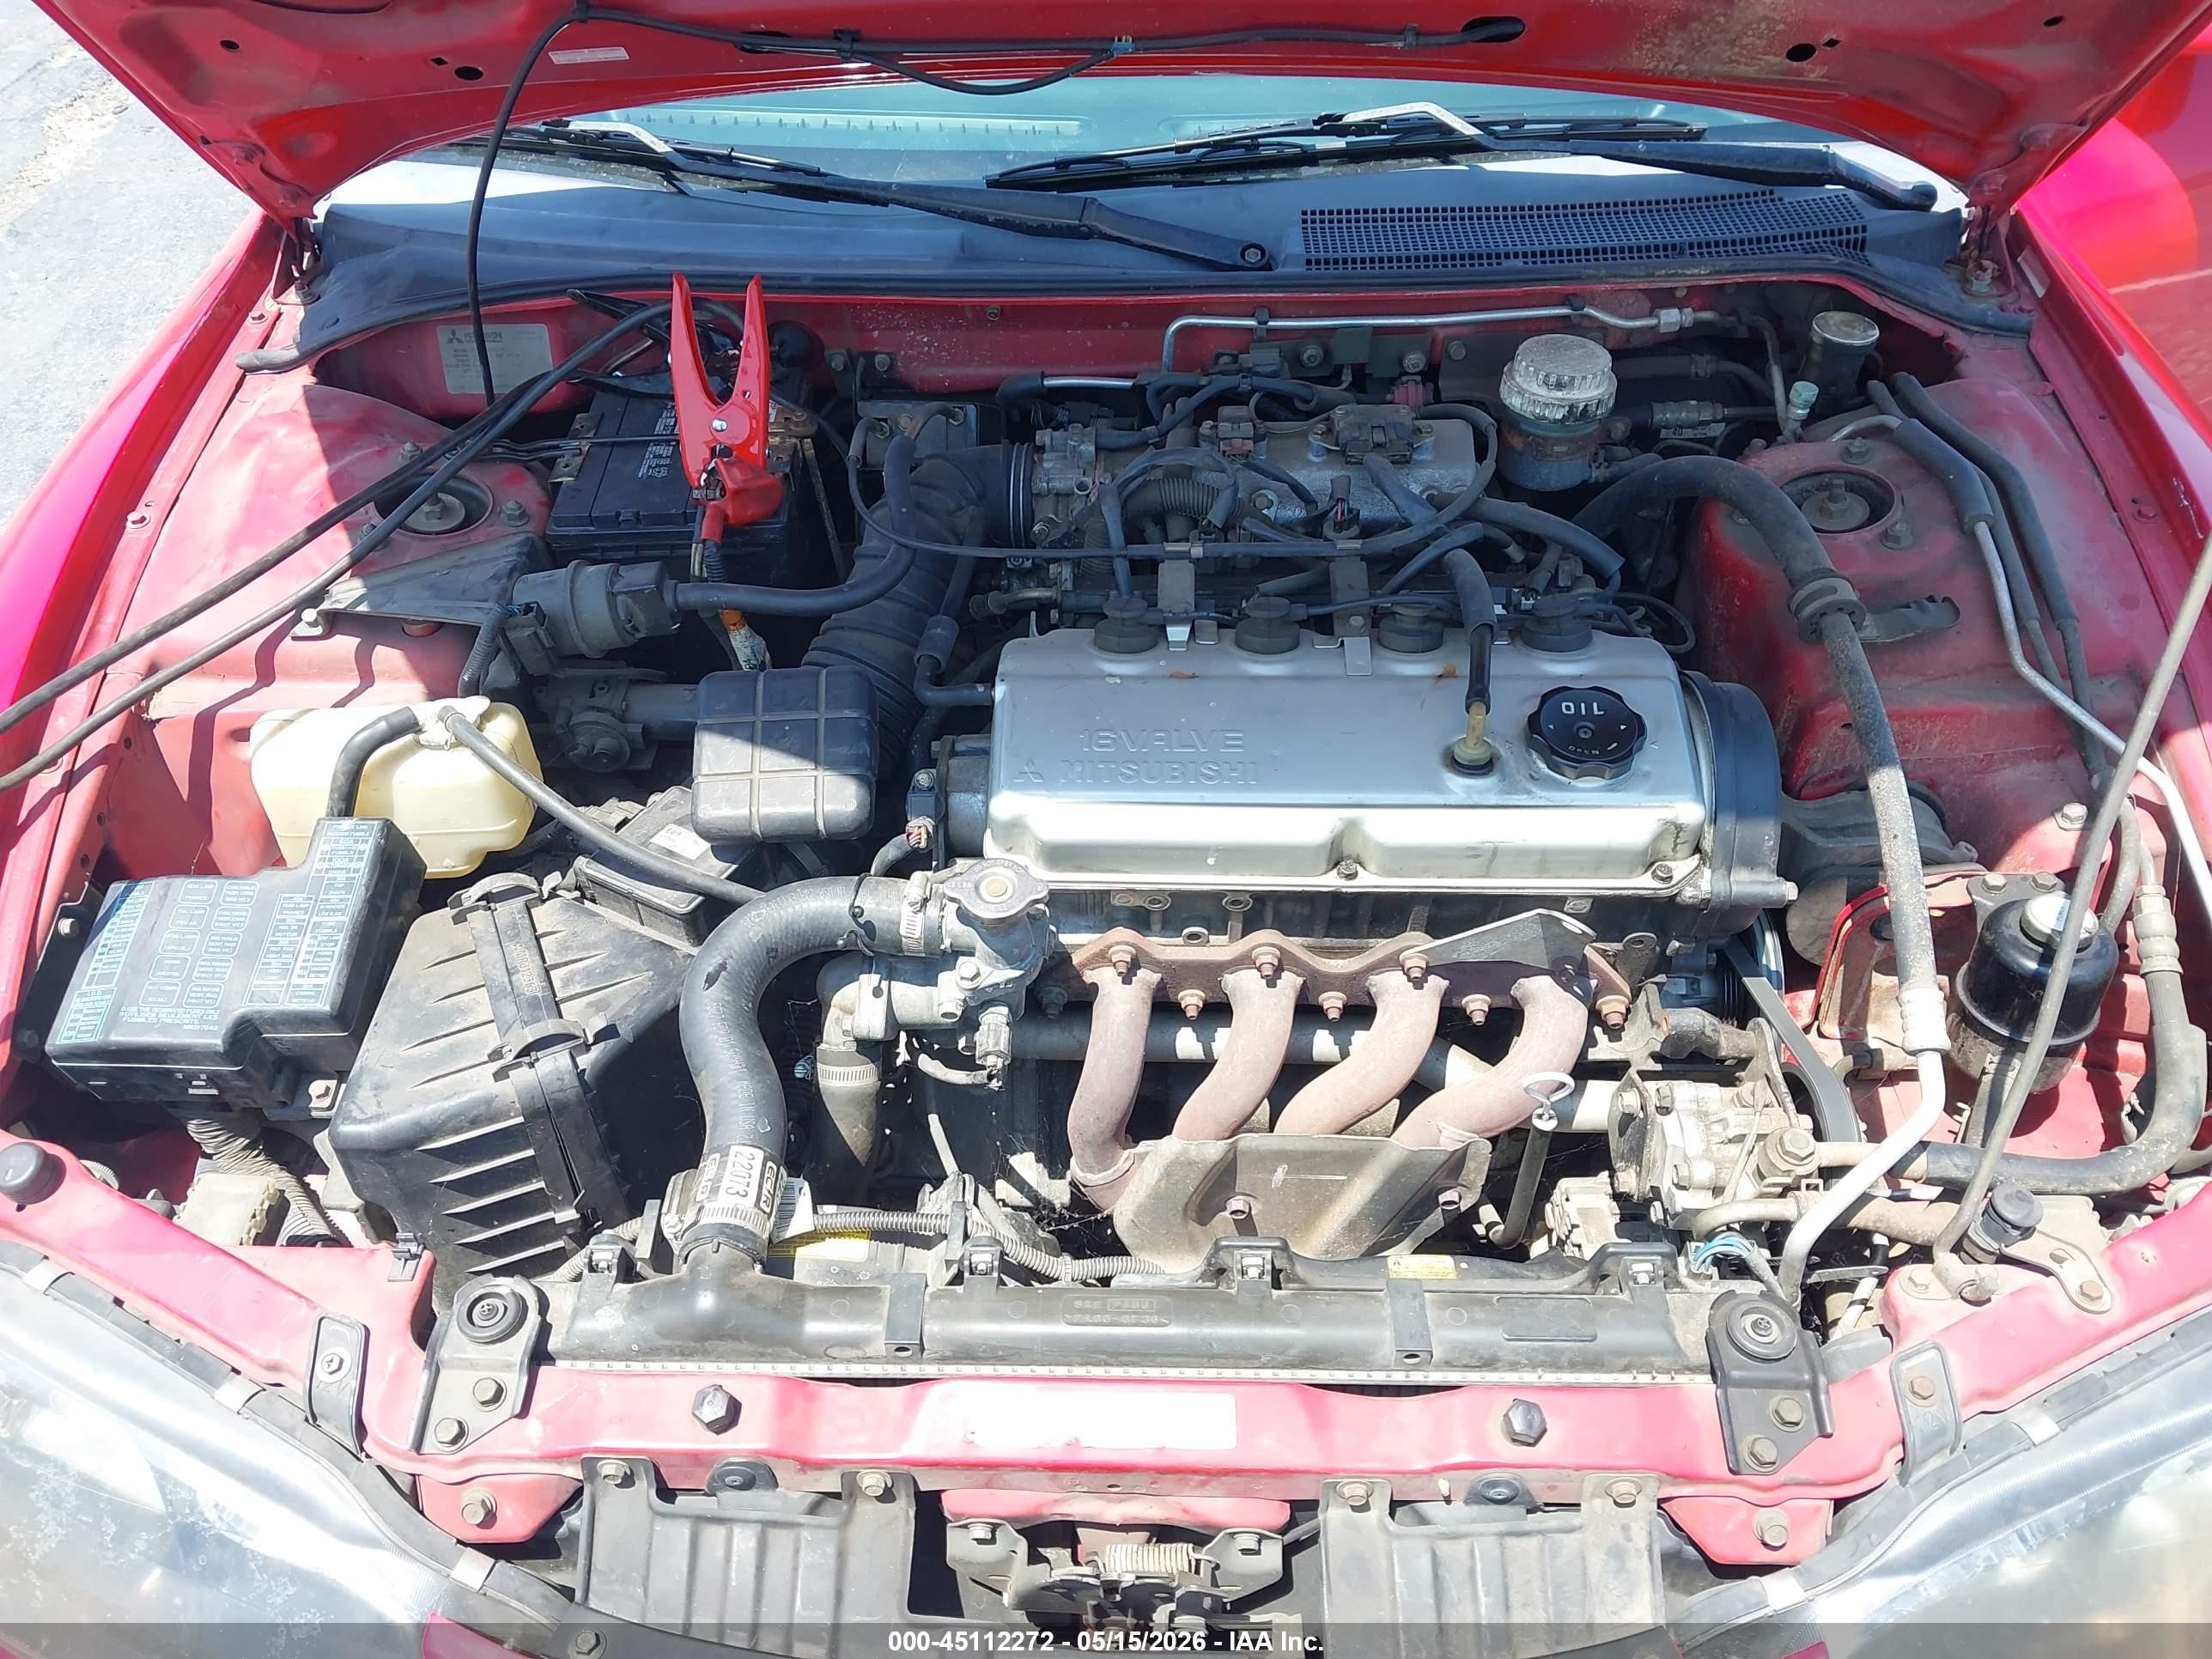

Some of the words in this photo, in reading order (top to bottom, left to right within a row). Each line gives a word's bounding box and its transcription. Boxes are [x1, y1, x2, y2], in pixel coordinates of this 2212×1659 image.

[1561, 702, 1604, 715] OIL
[1060, 760, 1258, 784] MITSUBISHI
[726, 1152, 755, 1199] 22073
